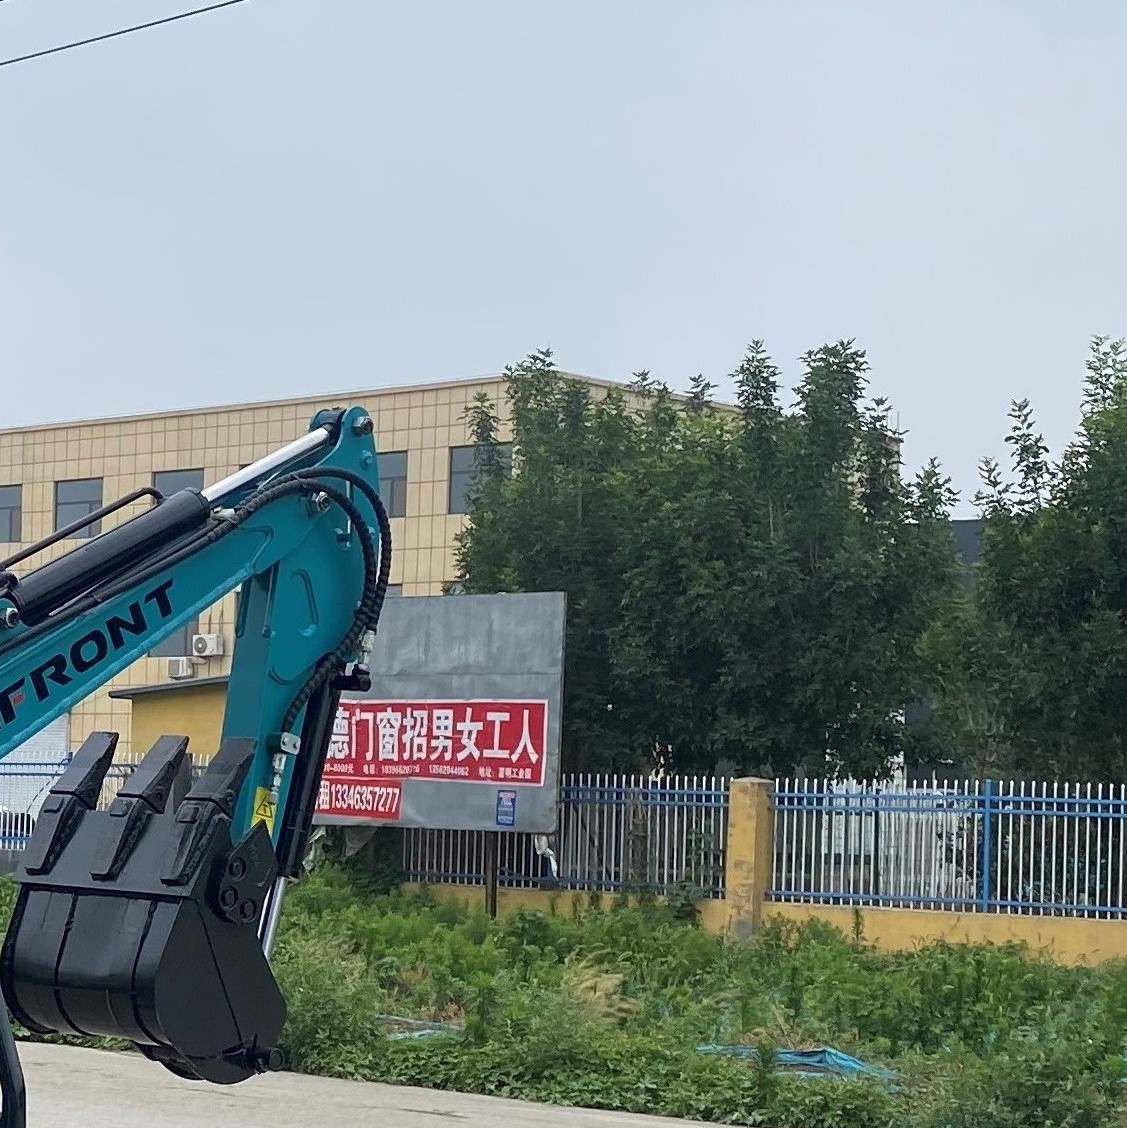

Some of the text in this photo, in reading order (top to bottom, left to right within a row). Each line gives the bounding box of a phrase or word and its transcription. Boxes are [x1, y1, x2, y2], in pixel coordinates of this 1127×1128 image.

[327, 706, 539, 764] 德门窗招男女工人
